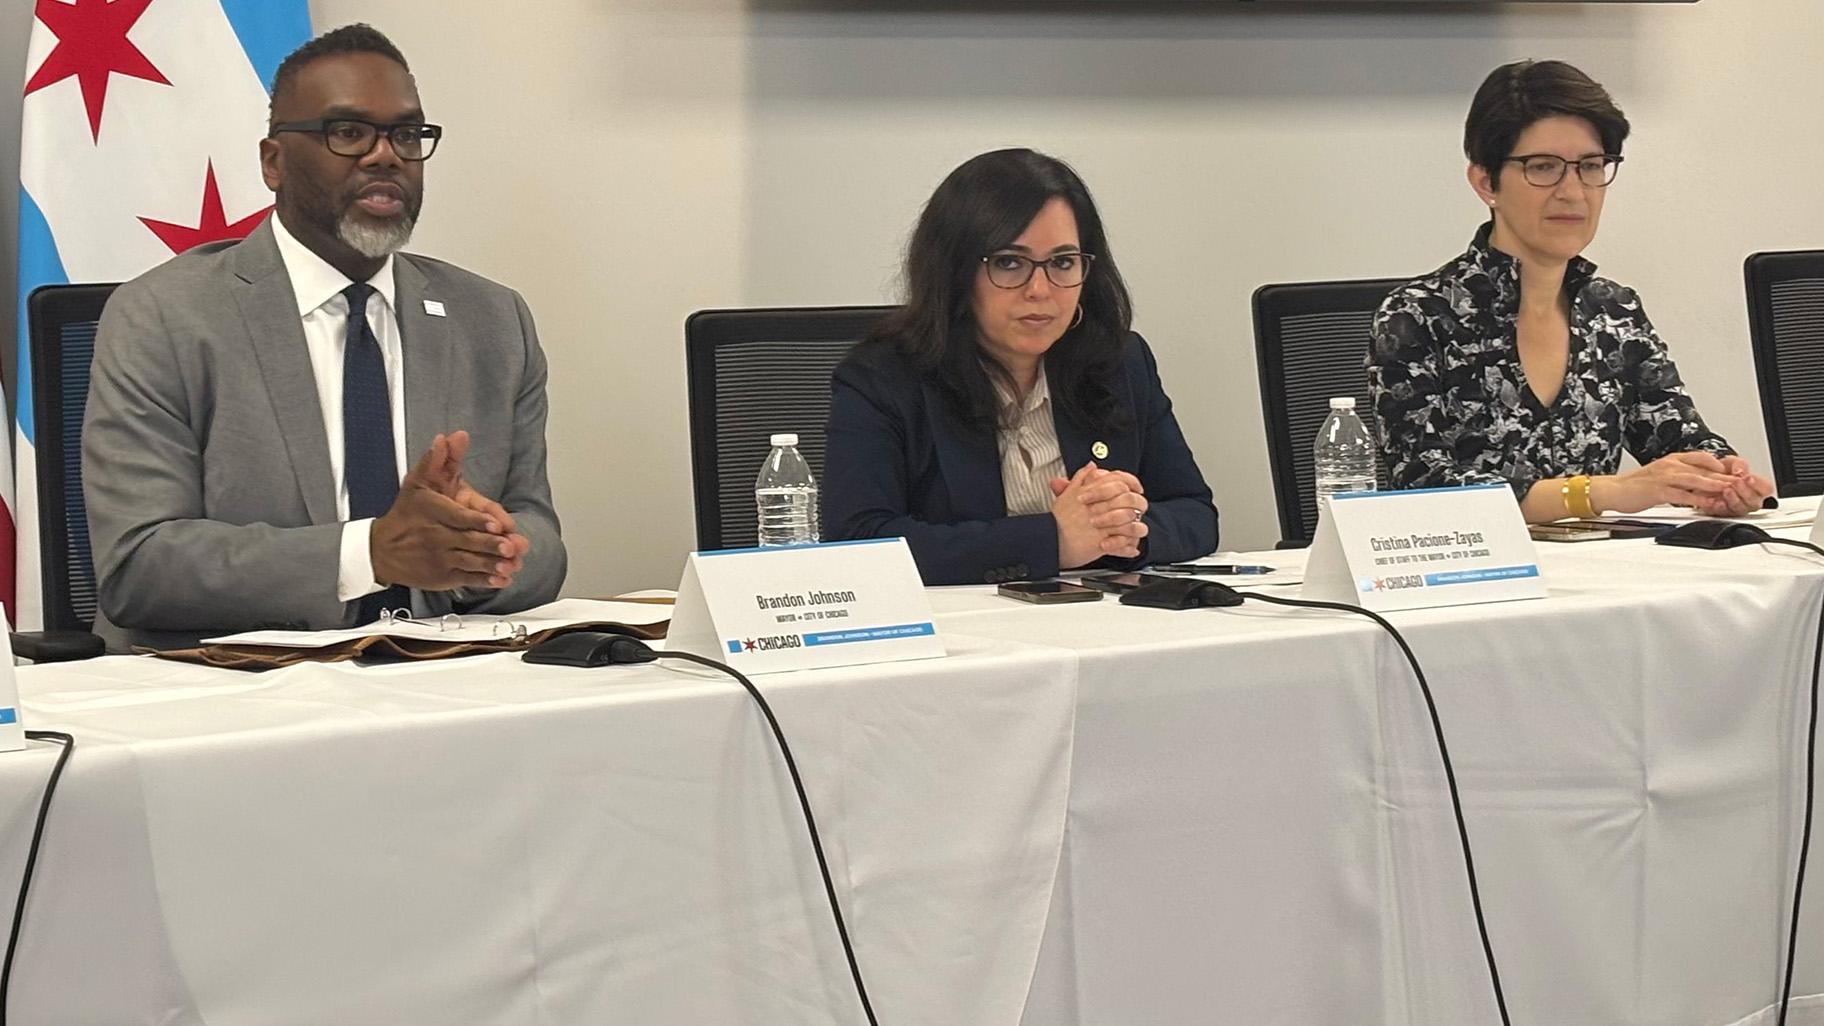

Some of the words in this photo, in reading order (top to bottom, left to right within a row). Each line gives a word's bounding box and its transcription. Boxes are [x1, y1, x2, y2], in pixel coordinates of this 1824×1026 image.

[1370, 536, 1411, 551] Cristina
[1411, 531, 1484, 548] Pacione-Zayas
[1386, 575, 1424, 590] CHICAGO
[756, 593, 806, 610] Brandon
[807, 590, 857, 606] Johnson
[757, 634, 802, 651] CHICAGO
